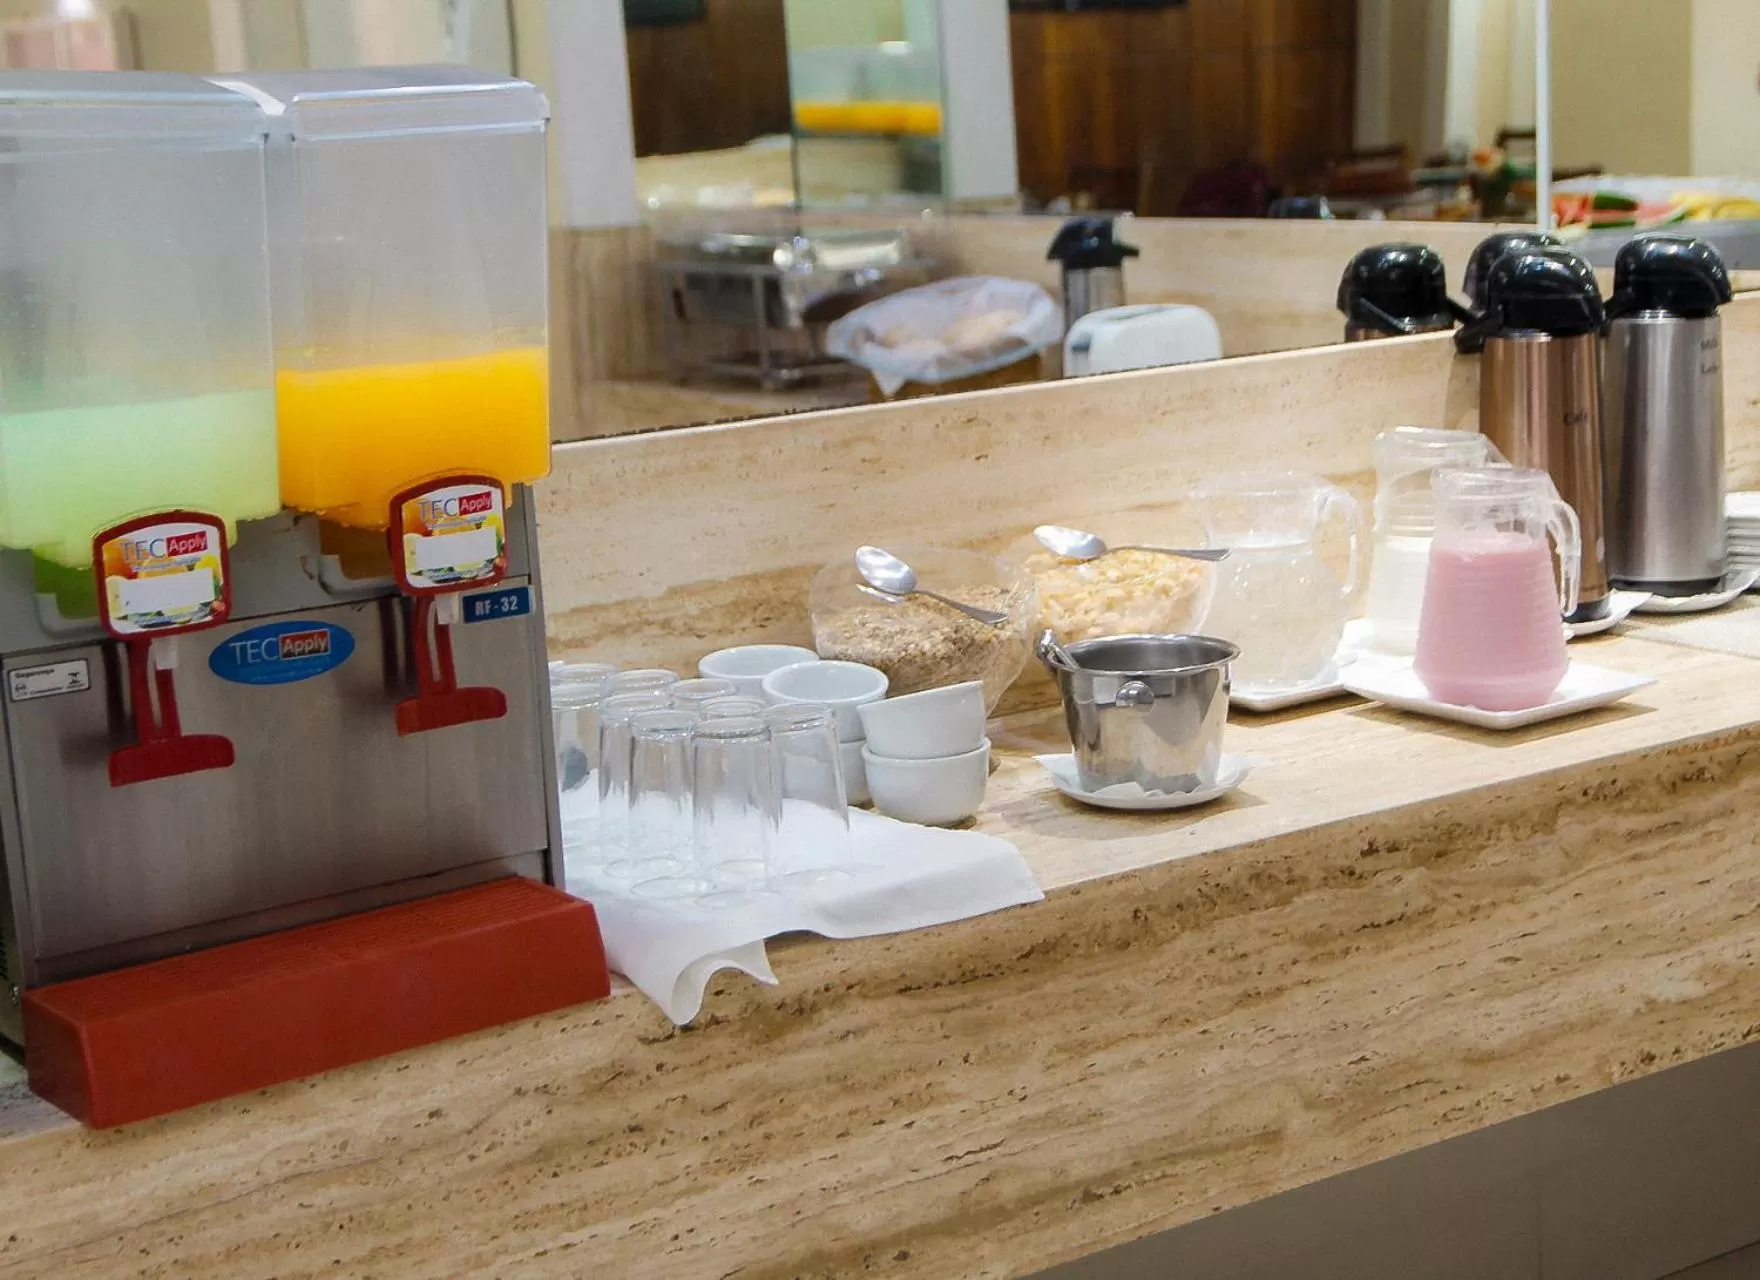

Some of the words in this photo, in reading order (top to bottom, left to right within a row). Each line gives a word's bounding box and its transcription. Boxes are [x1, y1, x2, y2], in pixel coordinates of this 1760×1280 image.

[418, 498, 458, 520] TEC
[460, 494, 491, 512] Apply
[120, 539, 166, 561] TEC
[168, 533, 206, 553] Apply
[228, 637, 278, 665] TEC
[283, 634, 327, 655] Apply
